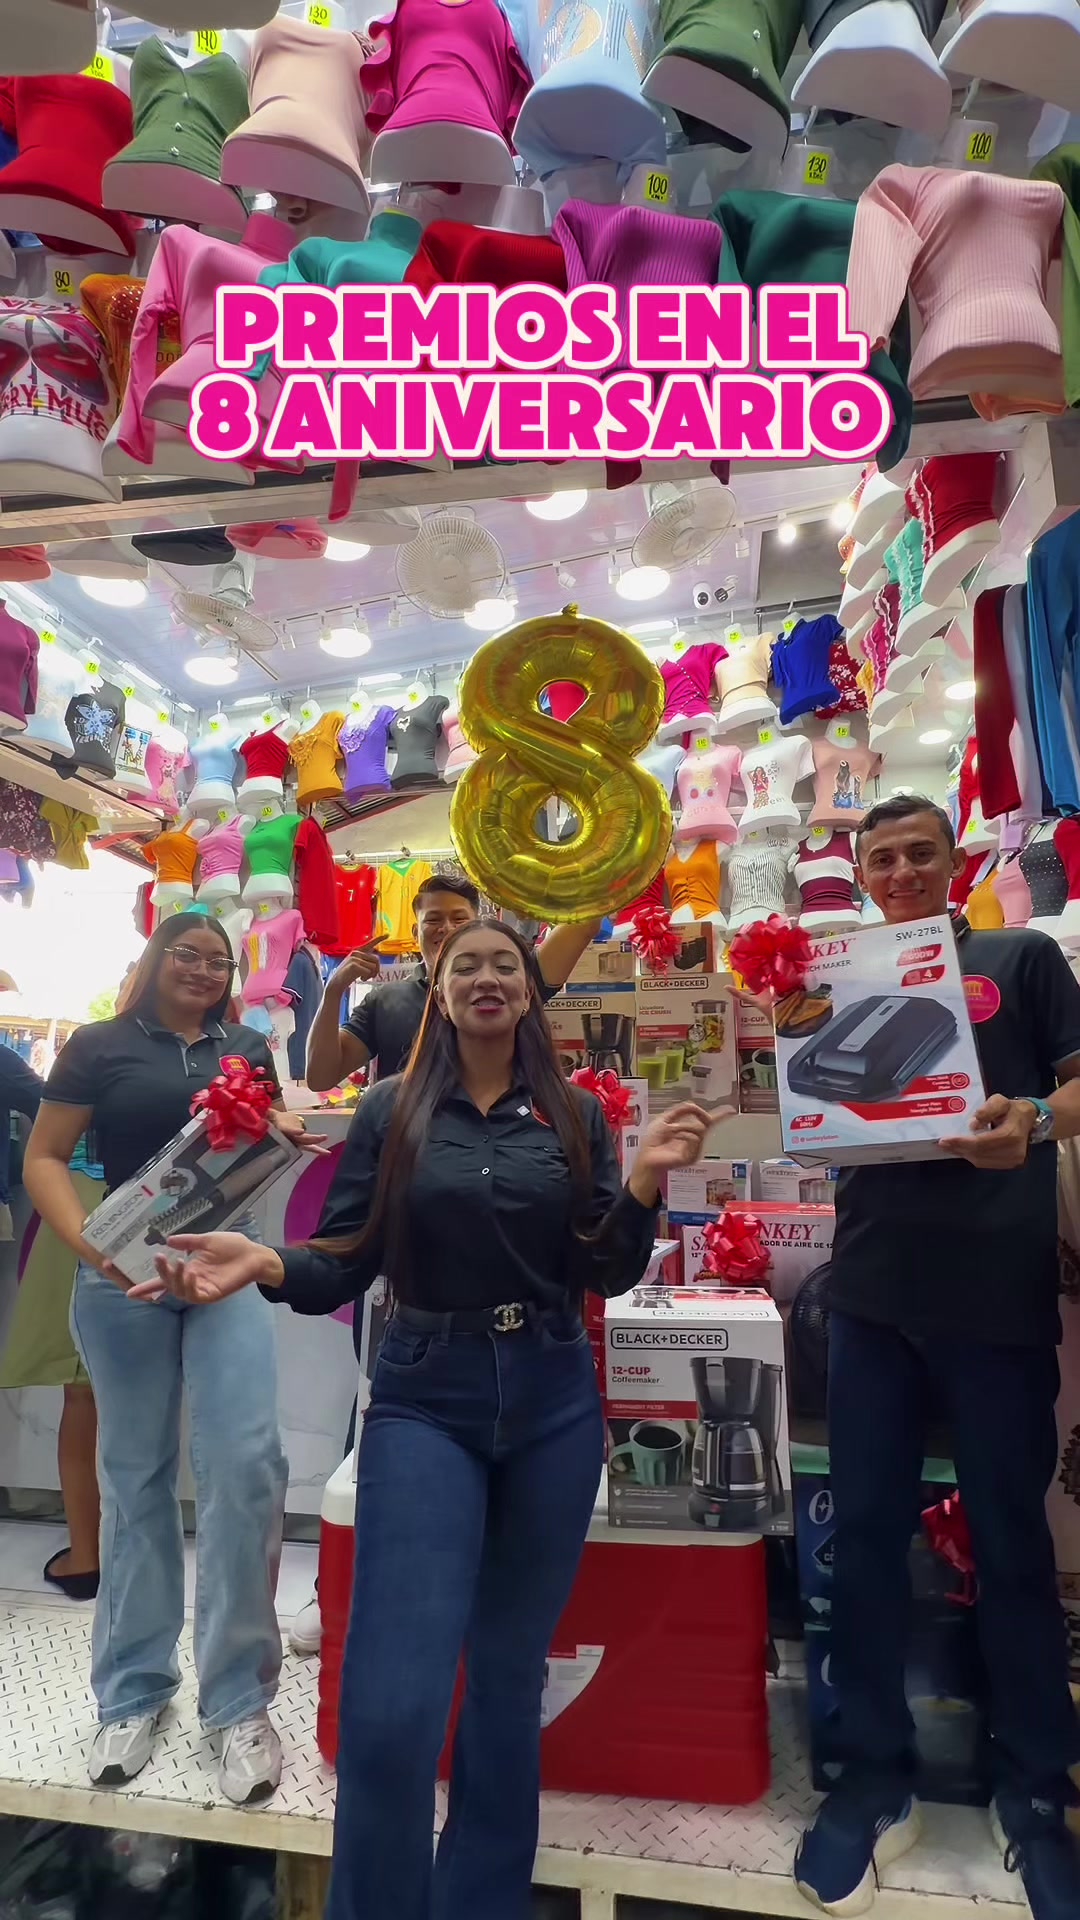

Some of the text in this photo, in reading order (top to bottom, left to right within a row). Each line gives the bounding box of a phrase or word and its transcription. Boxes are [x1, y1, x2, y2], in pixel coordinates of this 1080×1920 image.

[309, 5, 328, 20] 130
[197, 29, 218, 50] 140
[971, 132, 992, 155] 100
[808, 156, 827, 173] 130
[648, 173, 668, 195] 100
[55, 270, 70, 288] 80
[347, 889, 355, 902] 7
[895, 925, 944, 941] SW-27BL
[813, 939, 850, 958] KEY
[822, 960, 852, 970] MAKER
[545, 1000, 599, 1008] ACK+DECKER
[758, 1223, 816, 1240] NKEY
[615, 1333, 723, 1346] BLACK+DECKER
[611, 1366, 651, 1376] 12-CUP
[611, 1376, 660, 1384] Coffeemaker
